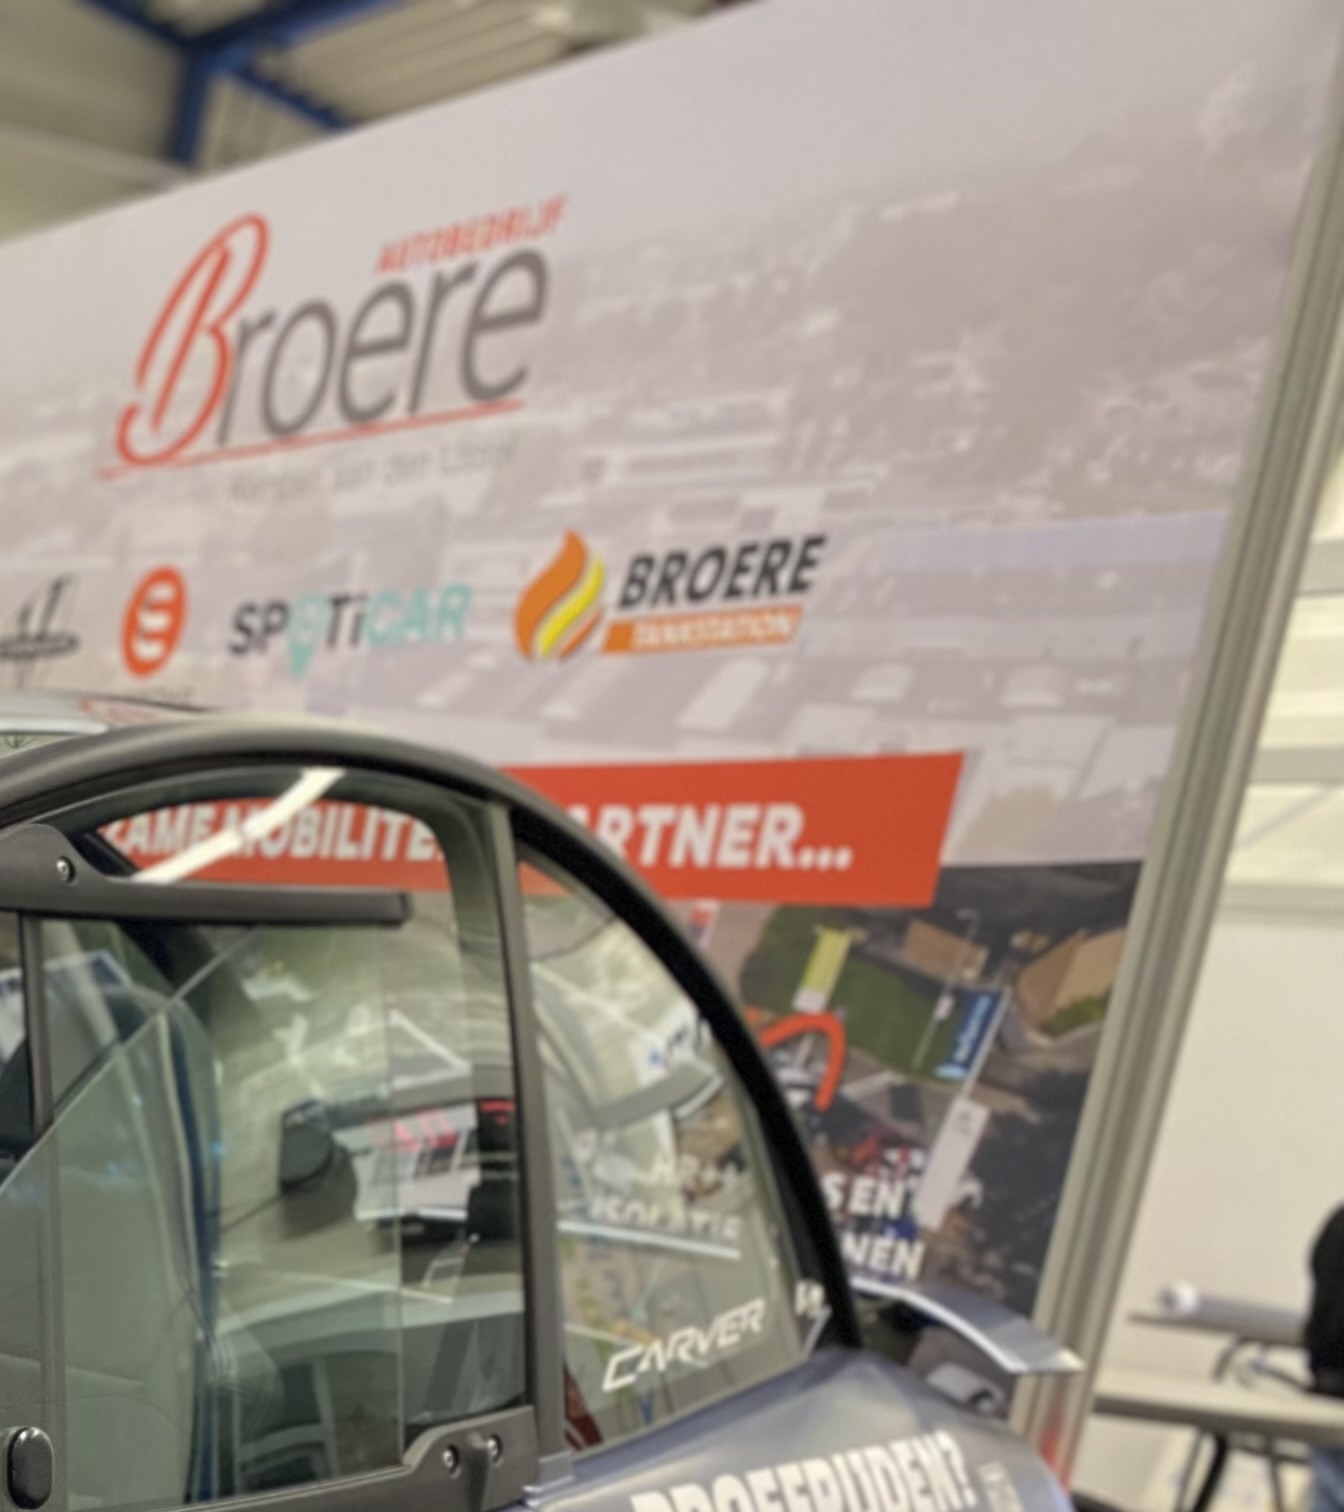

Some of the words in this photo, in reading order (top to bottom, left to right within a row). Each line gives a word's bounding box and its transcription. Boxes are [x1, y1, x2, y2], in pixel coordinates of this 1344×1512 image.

[115, 212, 549, 467] Broere
[617, 535, 827, 610] BROERE
[603, 1298, 766, 1393] CARVER
